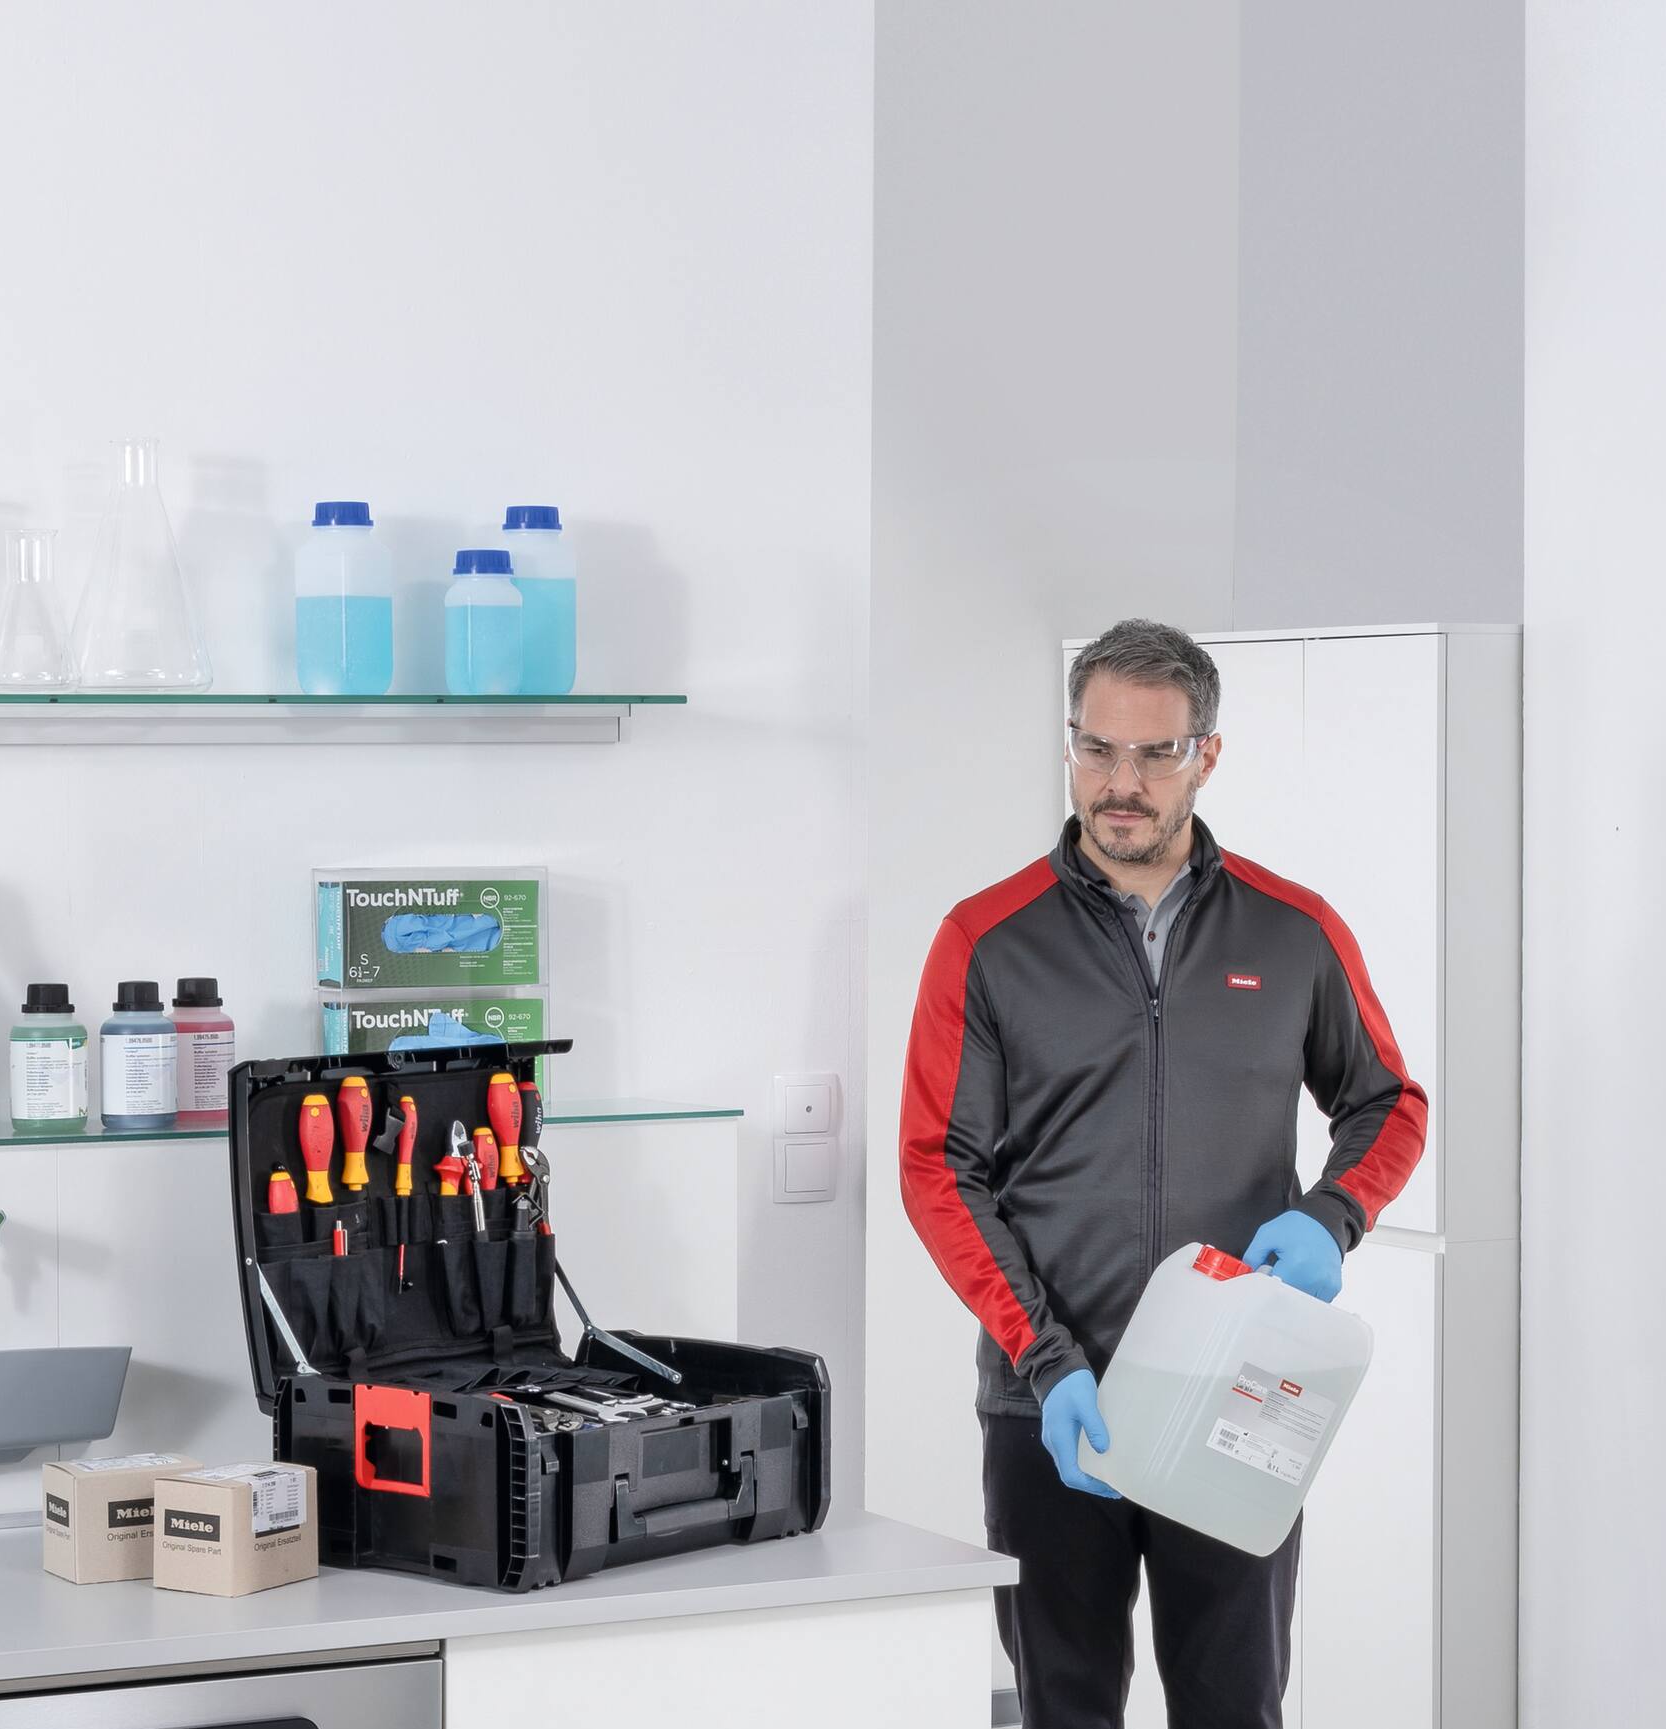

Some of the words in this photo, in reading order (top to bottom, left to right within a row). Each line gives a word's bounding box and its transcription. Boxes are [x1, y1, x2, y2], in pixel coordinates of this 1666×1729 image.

[360, 953, 369, 965] S
[1231, 977, 1257, 986] Miele
[351, 1008, 465, 1029] TouchNff
[361, 1104, 369, 1133] wiha
[535, 1106, 543, 1135] wiha
[1283, 1382, 1300, 1394] Miele
[47, 1500, 68, 1519] Miele
[116, 1506, 154, 1520] Miel
[170, 1517, 214, 1534] Miele
[107, 1529, 138, 1542] Original
[253, 1541, 276, 1552] Original
[277, 1533, 302, 1547] Ersatzteil
[162, 1540, 185, 1552] Original
[187, 1543, 206, 1555] Spare
[208, 1545, 222, 1556] Part
